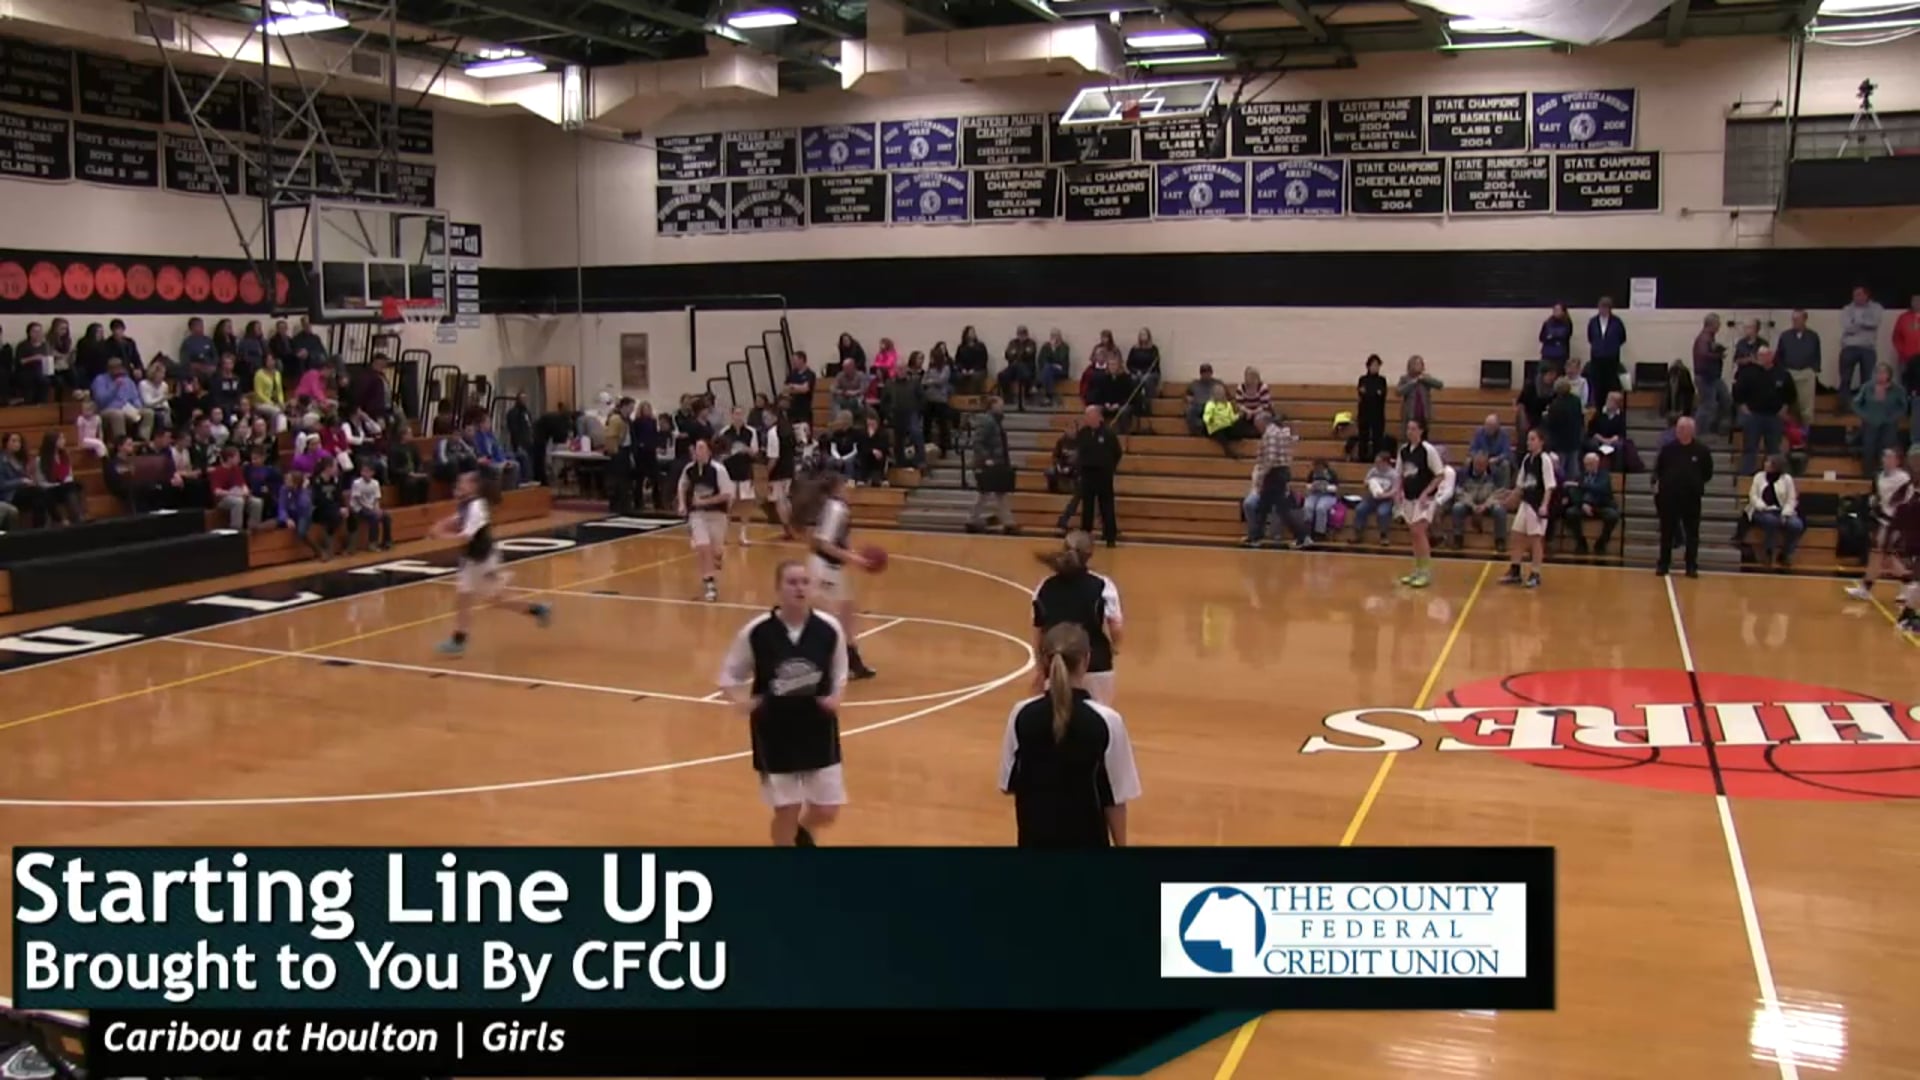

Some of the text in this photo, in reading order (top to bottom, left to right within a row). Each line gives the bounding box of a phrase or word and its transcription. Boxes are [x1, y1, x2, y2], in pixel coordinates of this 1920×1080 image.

[1339, 101, 1410, 112] EASTERN MAINE
[1435, 98, 1519, 109] STATE CHAMPIONS
[1569, 101, 1598, 111] AWARD
[1242, 104, 1310, 114] EASTERN MAINE
[963, 116, 1009, 128] EASTERN
[1247, 115, 1306, 125] CHAMPIONS
[1343, 112, 1407, 122] CHAMPIONS
[1432, 111, 1521, 124] BOYS BASKETBALL
[1360, 123, 1390, 131] 2004
[1451, 125, 1503, 135] CLASS C
[1539, 123, 1561, 132] EAST
[976, 127, 1032, 138] CHAMPIONS
[1334, 131, 1416, 141] BOYS BASKETBALL
[1245, 135, 1307, 144] GIRLS SOCCER
[1460, 138, 1492, 147] 2004
[1254, 145, 1286, 153] CLASS
[1351, 142, 1387, 150] CLASS
[1356, 161, 1439, 172] STATE CHAMPIONS
[1455, 157, 1546, 169] STATE RUNNERS-UP
[1564, 156, 1650, 169] STATE CHAMPIONS
[984, 171, 1020, 181] EASTERN
[1095, 169, 1150, 182] CHAMPIONS
[1453, 168, 1547, 180] EASTERN MAINE CHAMPIONS
[1563, 171, 1651, 183] CHEERLEADING
[987, 180, 1042, 191] CHAMPIONS
[1355, 175, 1441, 187] CHEERLEADING
[1484, 181, 1516, 190] 2004
[1069, 182, 1145, 195] CHEERLEADING
[1257, 189, 1278, 198] EAST
[1372, 189, 1423, 198] CLASS C
[1580, 184, 1633, 195] CLASS C
[1163, 191, 1183, 199] EAST
[1469, 190, 1531, 200] SOFTBALL
[987, 199, 1041, 208] CHEERLEADING
[1084, 198, 1117, 206] CLASS
[1381, 201, 1413, 210] 2004
[1475, 200, 1525, 209] CLASS C
[993, 208, 1024, 217] CLASS
